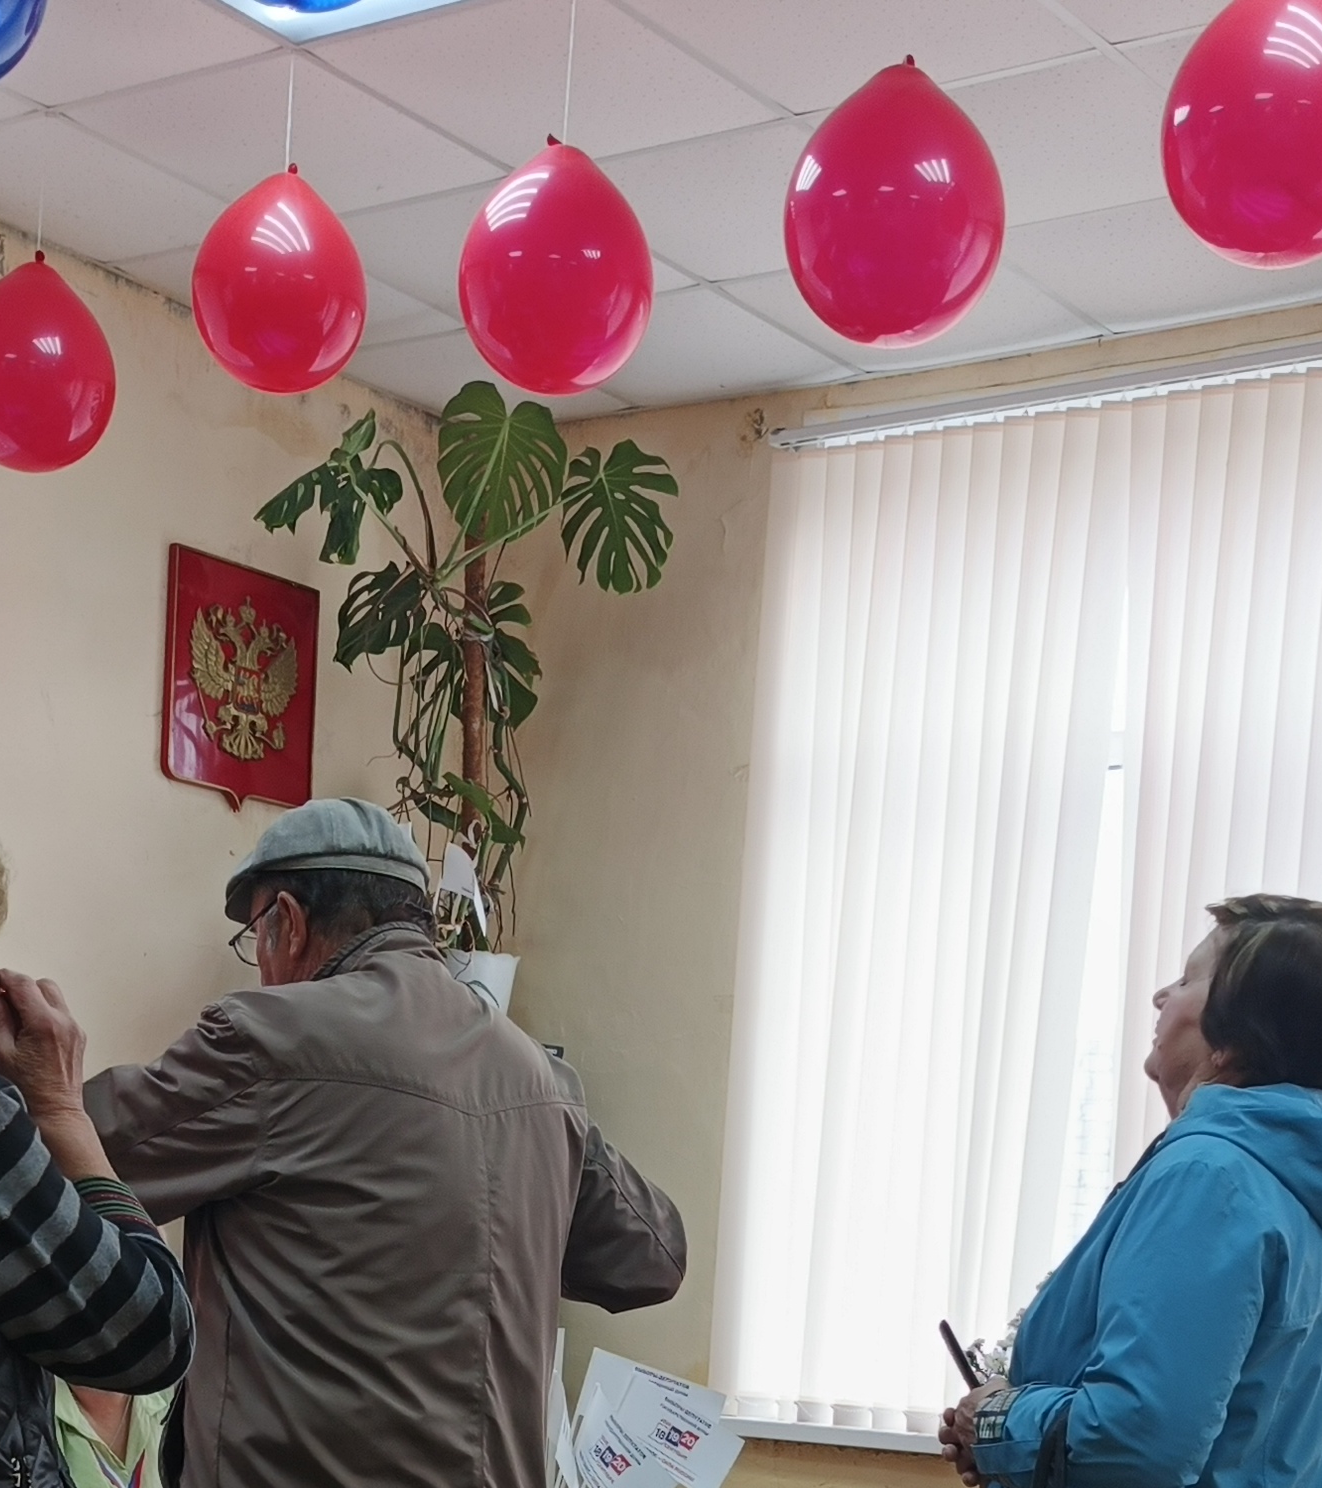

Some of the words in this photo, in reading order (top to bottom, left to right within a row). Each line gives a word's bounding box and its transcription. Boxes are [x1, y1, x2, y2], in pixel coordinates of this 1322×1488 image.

[668, 1429, 679, 1441] 19
[681, 1432, 696, 1445] 20
[611, 1455, 626, 1472] 20
